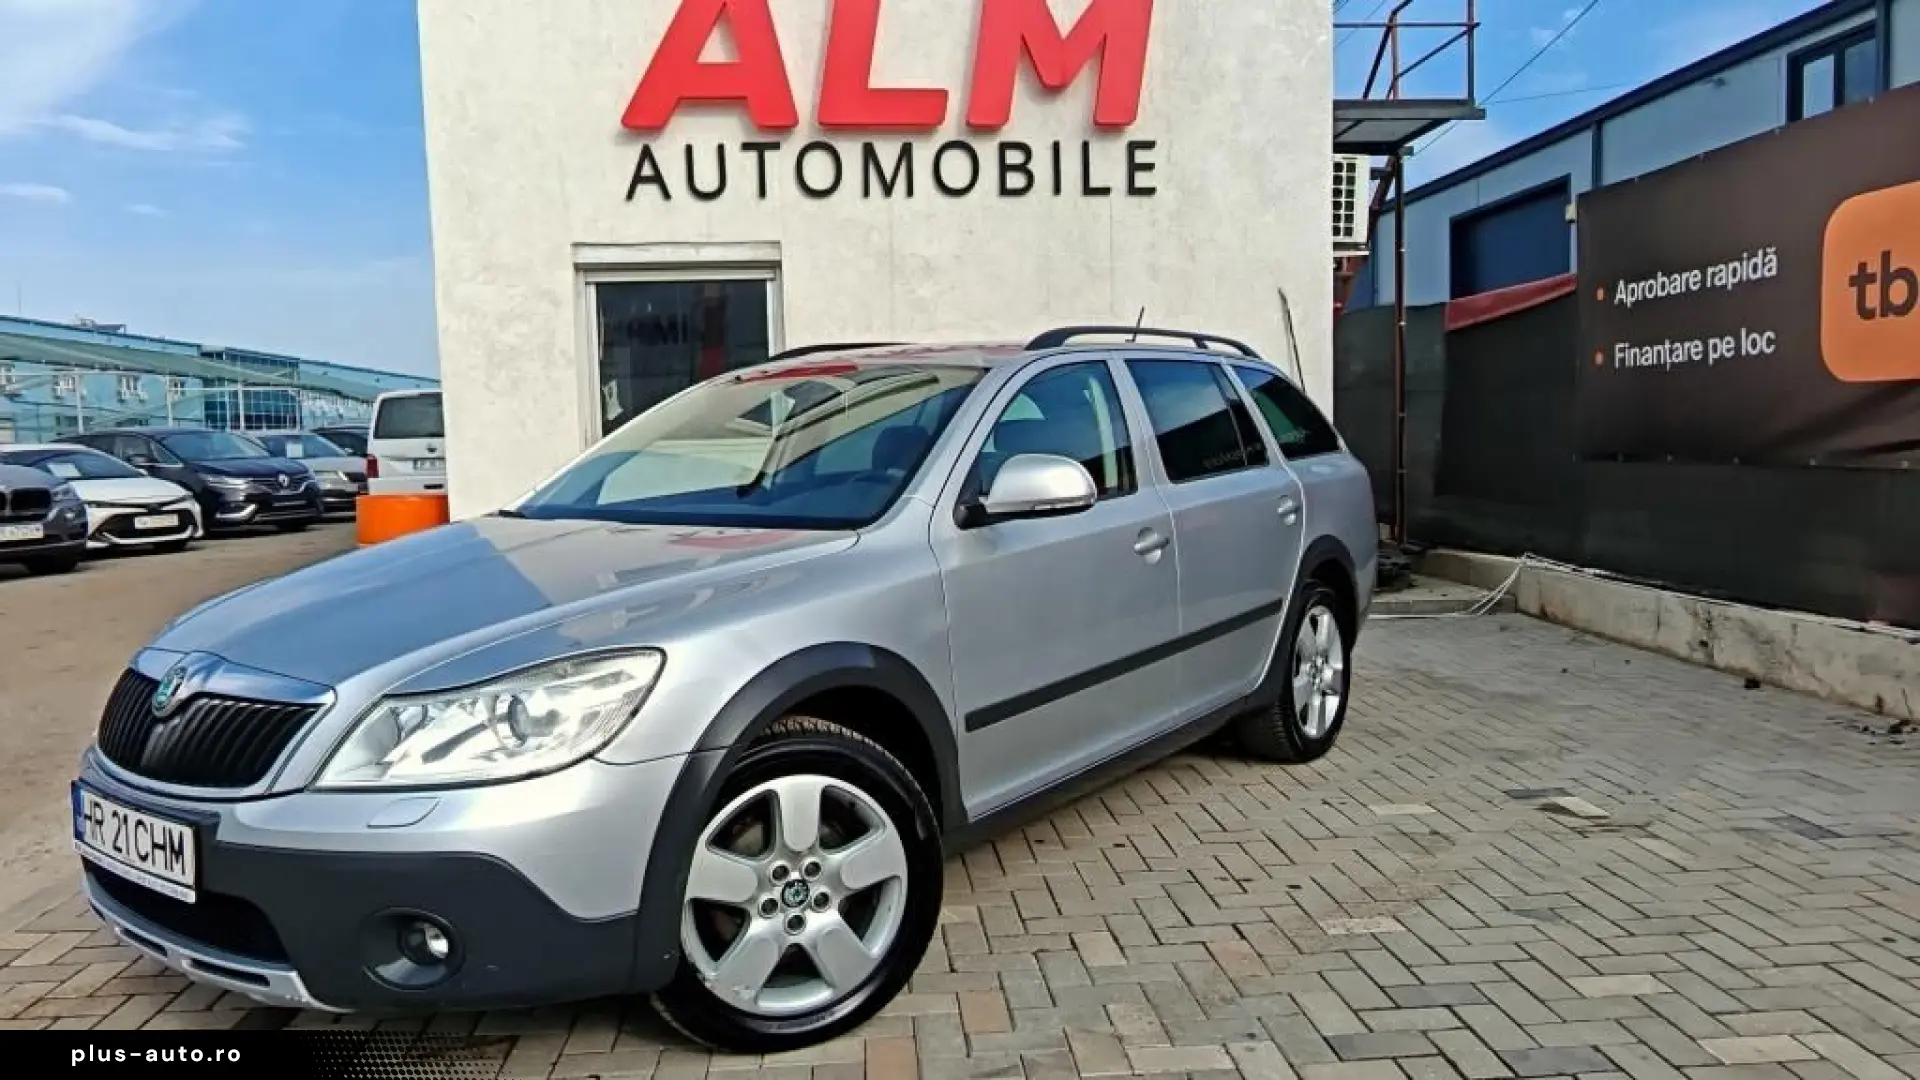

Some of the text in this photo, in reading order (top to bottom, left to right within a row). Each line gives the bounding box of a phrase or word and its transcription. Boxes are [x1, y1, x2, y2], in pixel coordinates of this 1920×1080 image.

[621, 0, 1153, 129] ALM
[626, 139, 1158, 201] AUTOMOBILE
[1613, 246, 1779, 308] Aprobare rapidă
[1707, 335, 1736, 367] pe
[1740, 327, 1777, 356] loc
